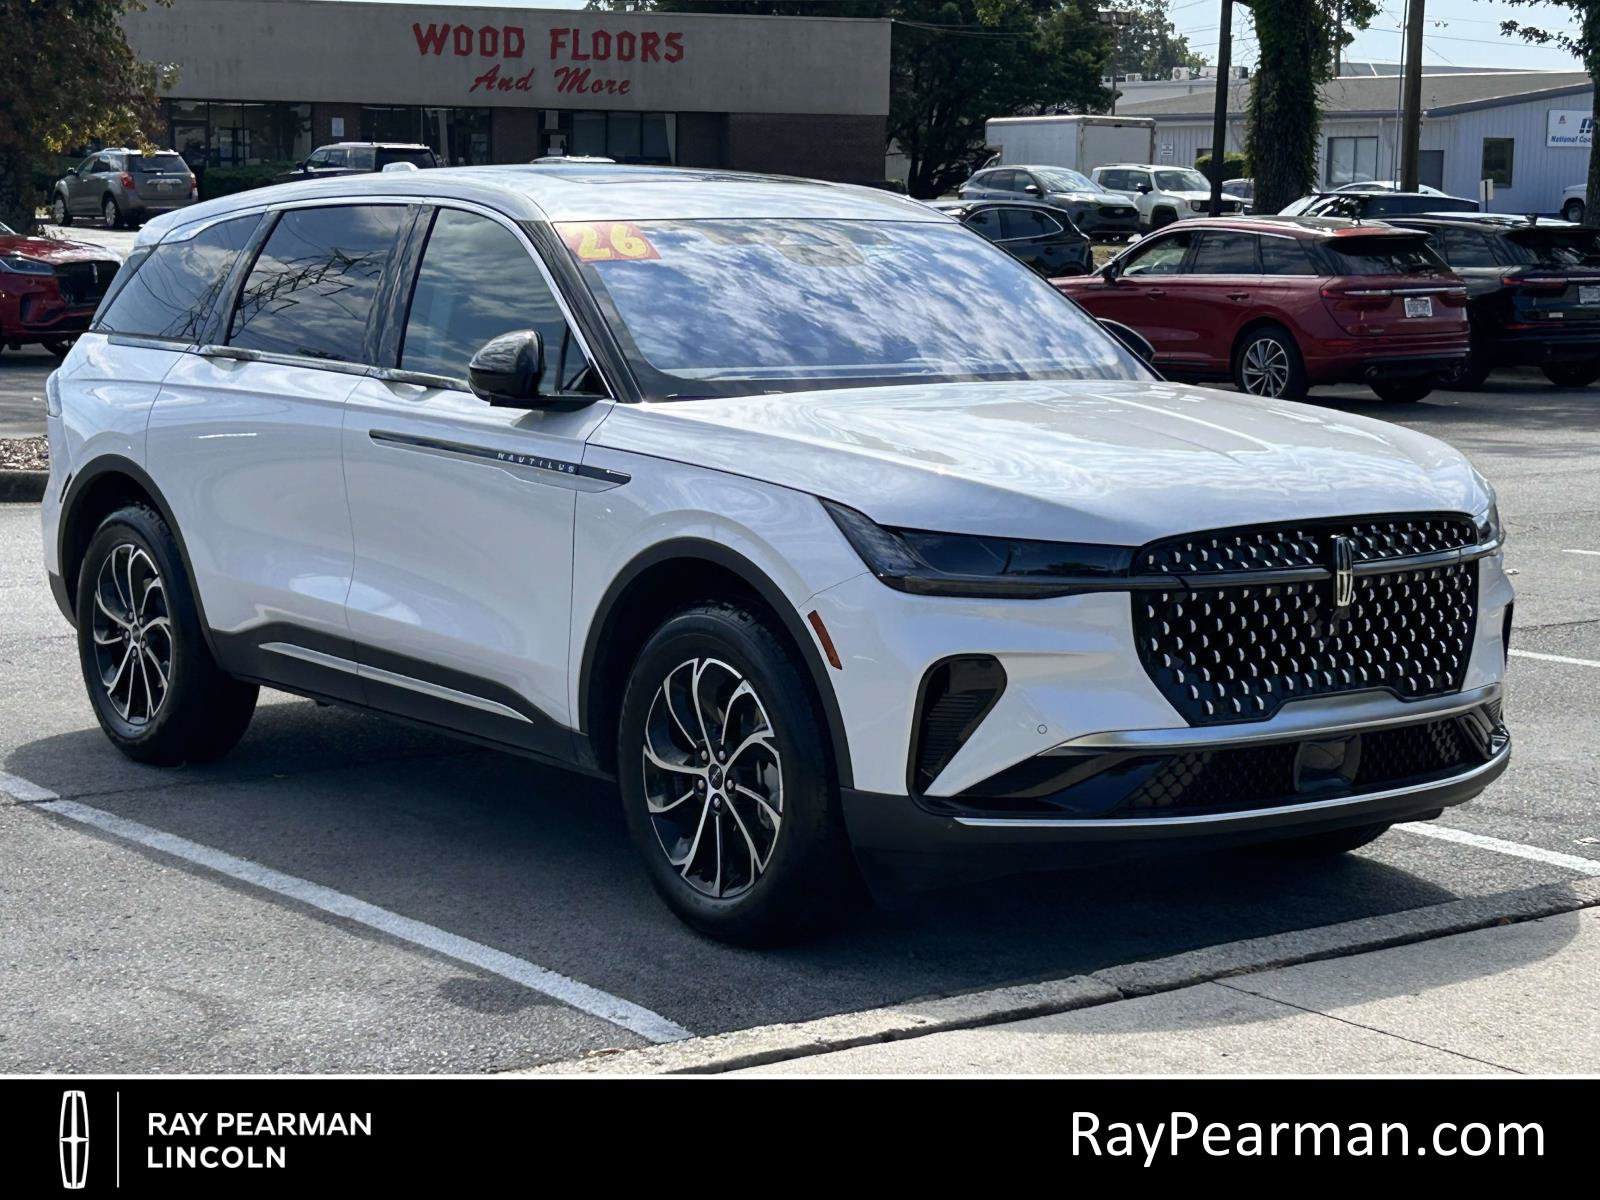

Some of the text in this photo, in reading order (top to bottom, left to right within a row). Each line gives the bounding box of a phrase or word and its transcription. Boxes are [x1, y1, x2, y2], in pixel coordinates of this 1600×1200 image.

[412, 23, 684, 63] WOOD FLOORS
[469, 64, 631, 95] And More
[560, 223, 648, 258] 26
[497, 452, 575, 473] NAUTILUS
